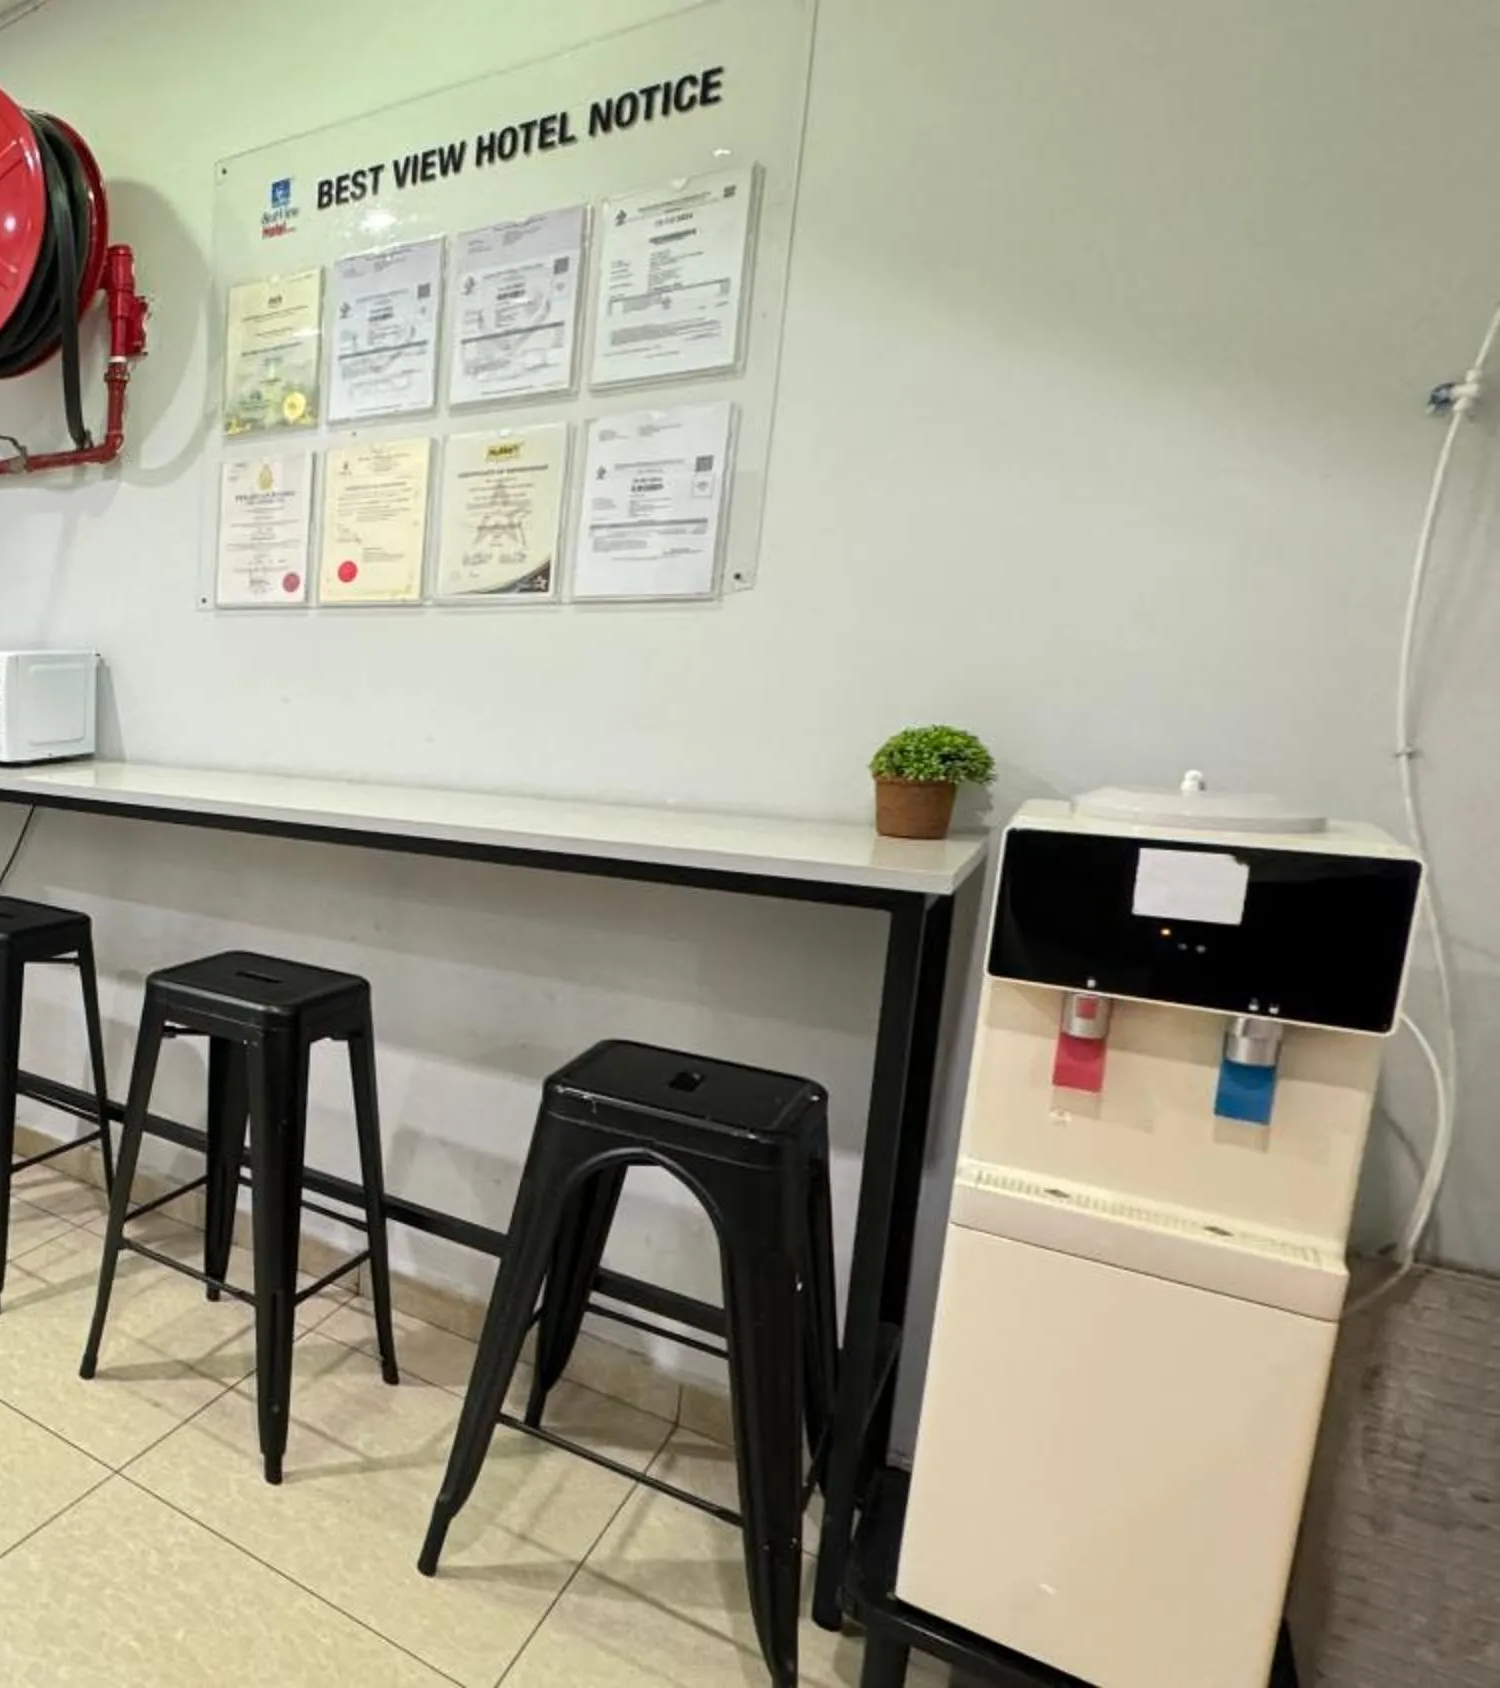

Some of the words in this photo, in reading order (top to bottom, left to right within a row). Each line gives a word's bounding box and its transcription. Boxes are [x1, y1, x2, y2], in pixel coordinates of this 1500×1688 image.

[316, 163, 385, 210] BEST
[393, 140, 468, 190] VIEW
[475, 111, 577, 168] HOTEL
[588, 66, 725, 137] NOTICE
